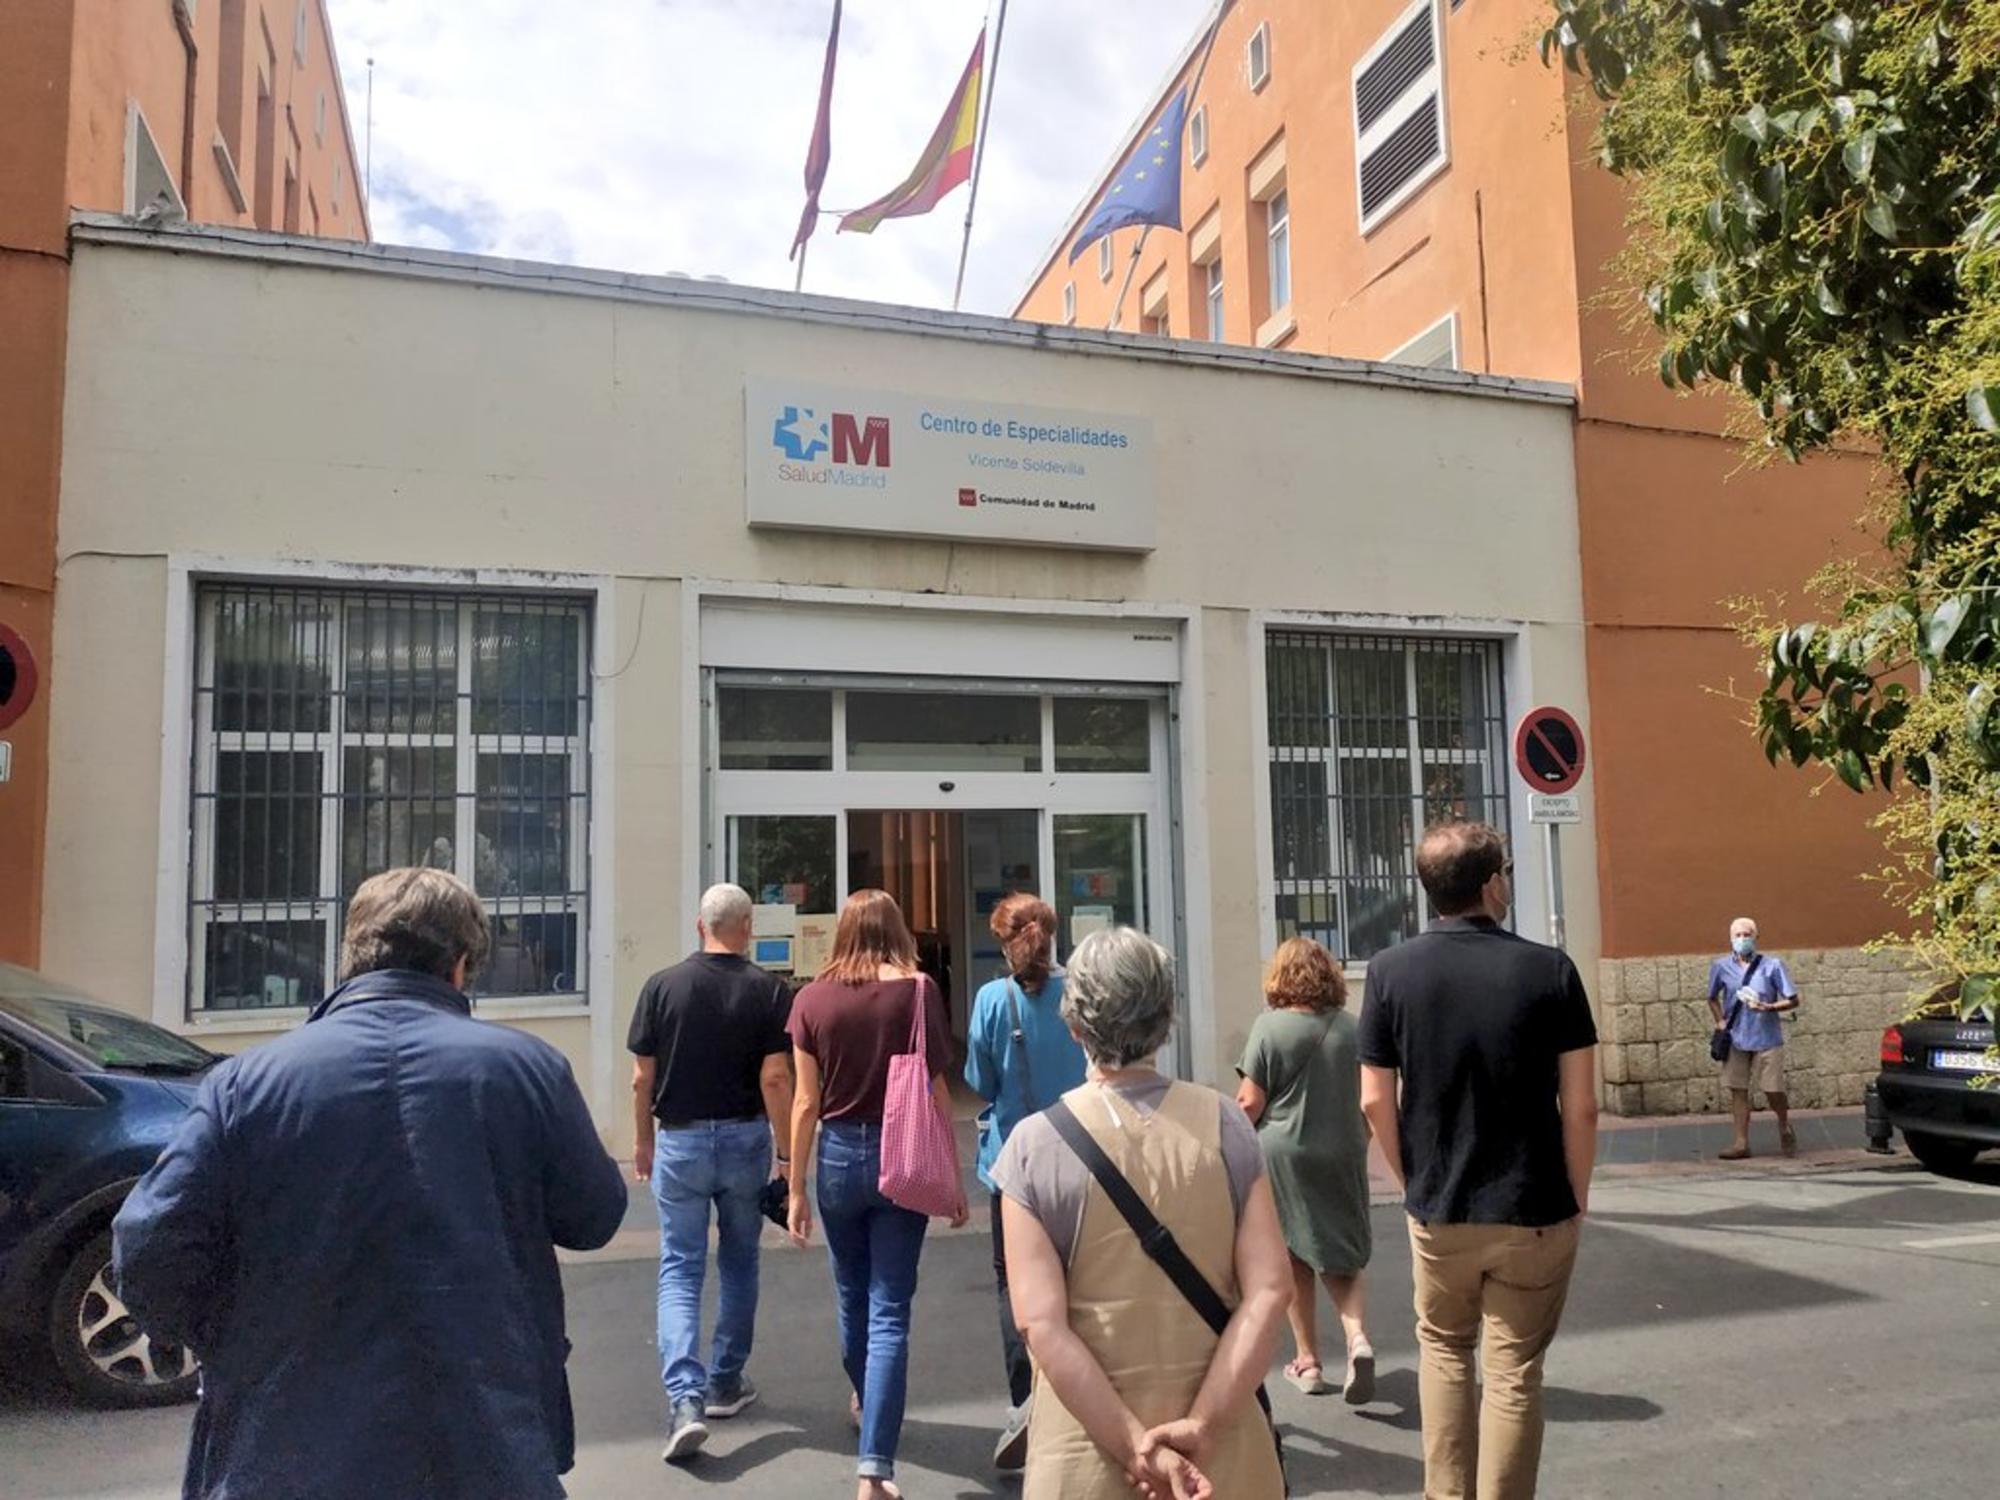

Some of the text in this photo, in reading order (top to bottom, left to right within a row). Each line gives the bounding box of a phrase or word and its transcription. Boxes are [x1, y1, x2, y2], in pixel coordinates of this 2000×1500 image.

[921, 412, 1128, 448] Centro de Especialidades
[968, 452, 1085, 476] Vicente Soldevilla
[980, 493, 1096, 511] Comunidad de Madrid
